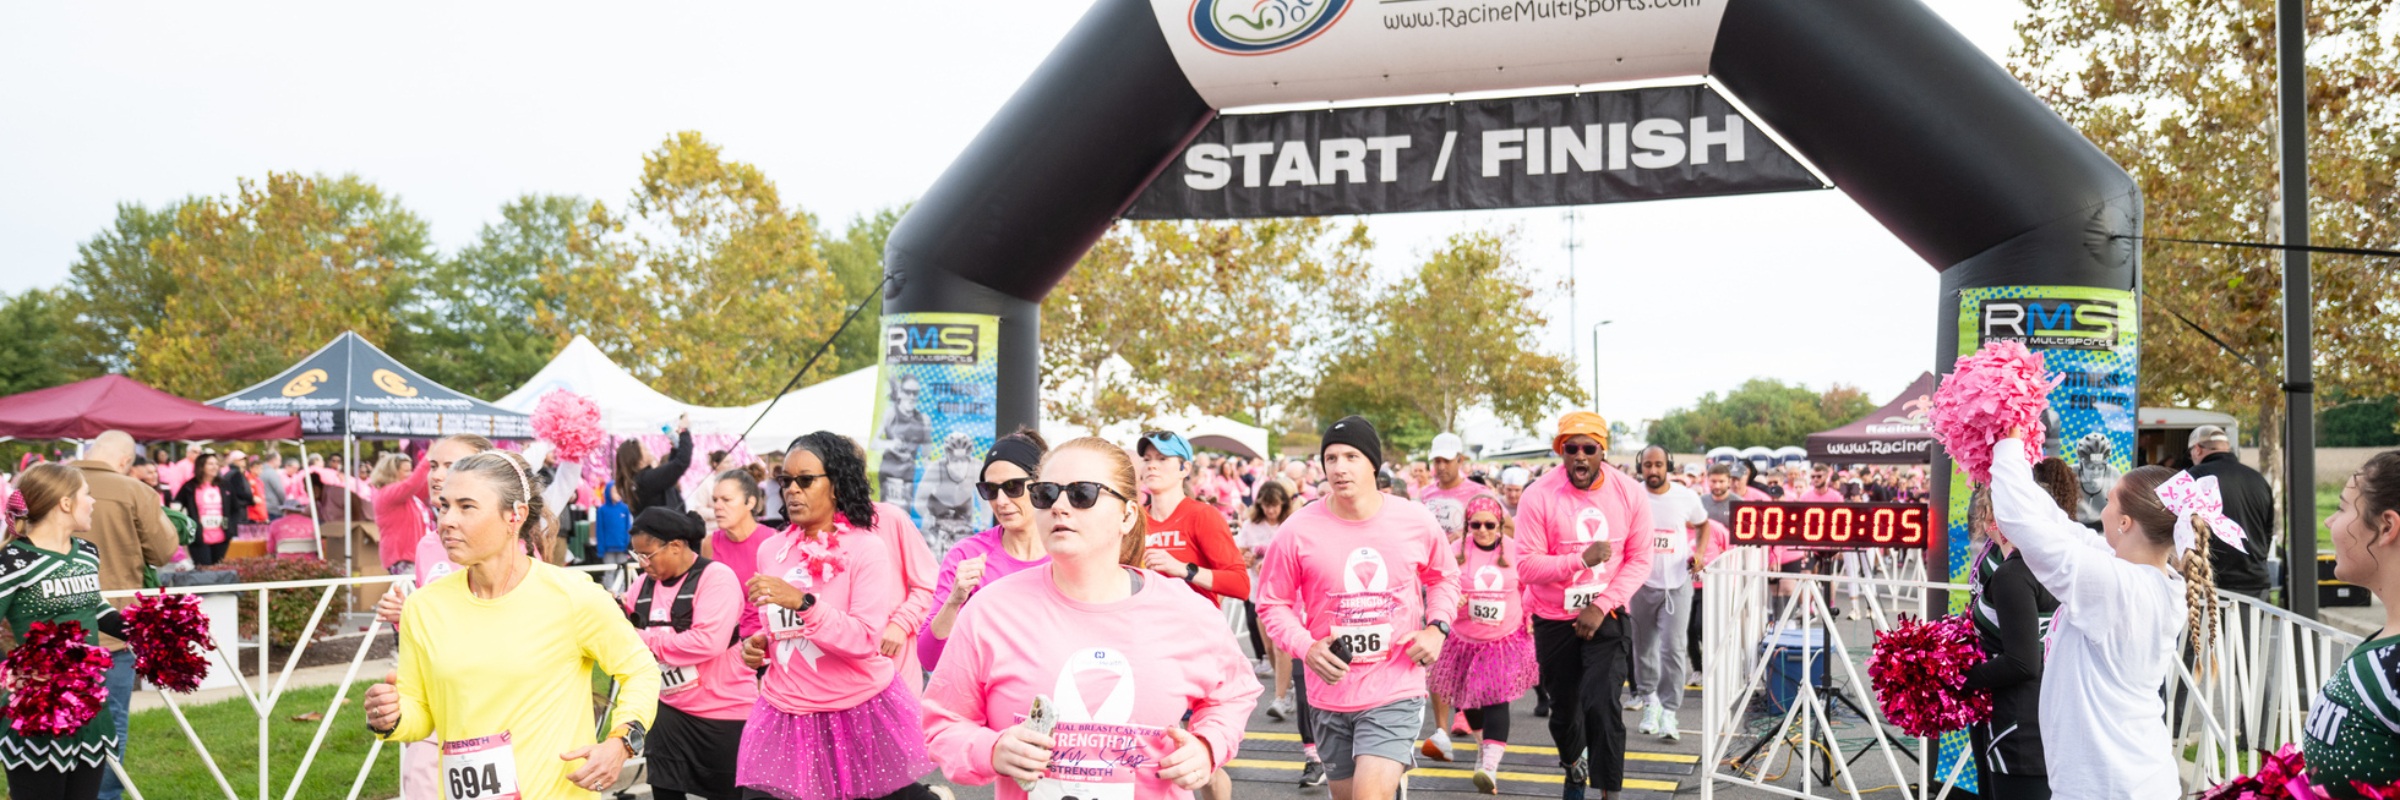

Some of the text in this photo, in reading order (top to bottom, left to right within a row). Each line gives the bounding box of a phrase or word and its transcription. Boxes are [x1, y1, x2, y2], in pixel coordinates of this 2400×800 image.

[1184, 114, 1745, 190] START / FINISH
[1984, 303, 2113, 338] RMS
[887, 326, 975, 356] RMS
[2070, 395, 2098, 410] FOR
[1826, 439, 1931, 454] www.Racine
[1735, 507, 1922, 542] 00:00:05
[1653, 537, 1669, 549] 73
[1474, 604, 1499, 619] 532
[1341, 633, 1380, 653] 836
[1078, 724, 1112, 734] BREAST
[445, 736, 490, 750] TRENGTH
[1052, 733, 1116, 749] TRENGTH
[1050, 747, 1087, 766] ery
[1050, 765, 1113, 776] STRENGTH
[449, 762, 502, 800] 694
